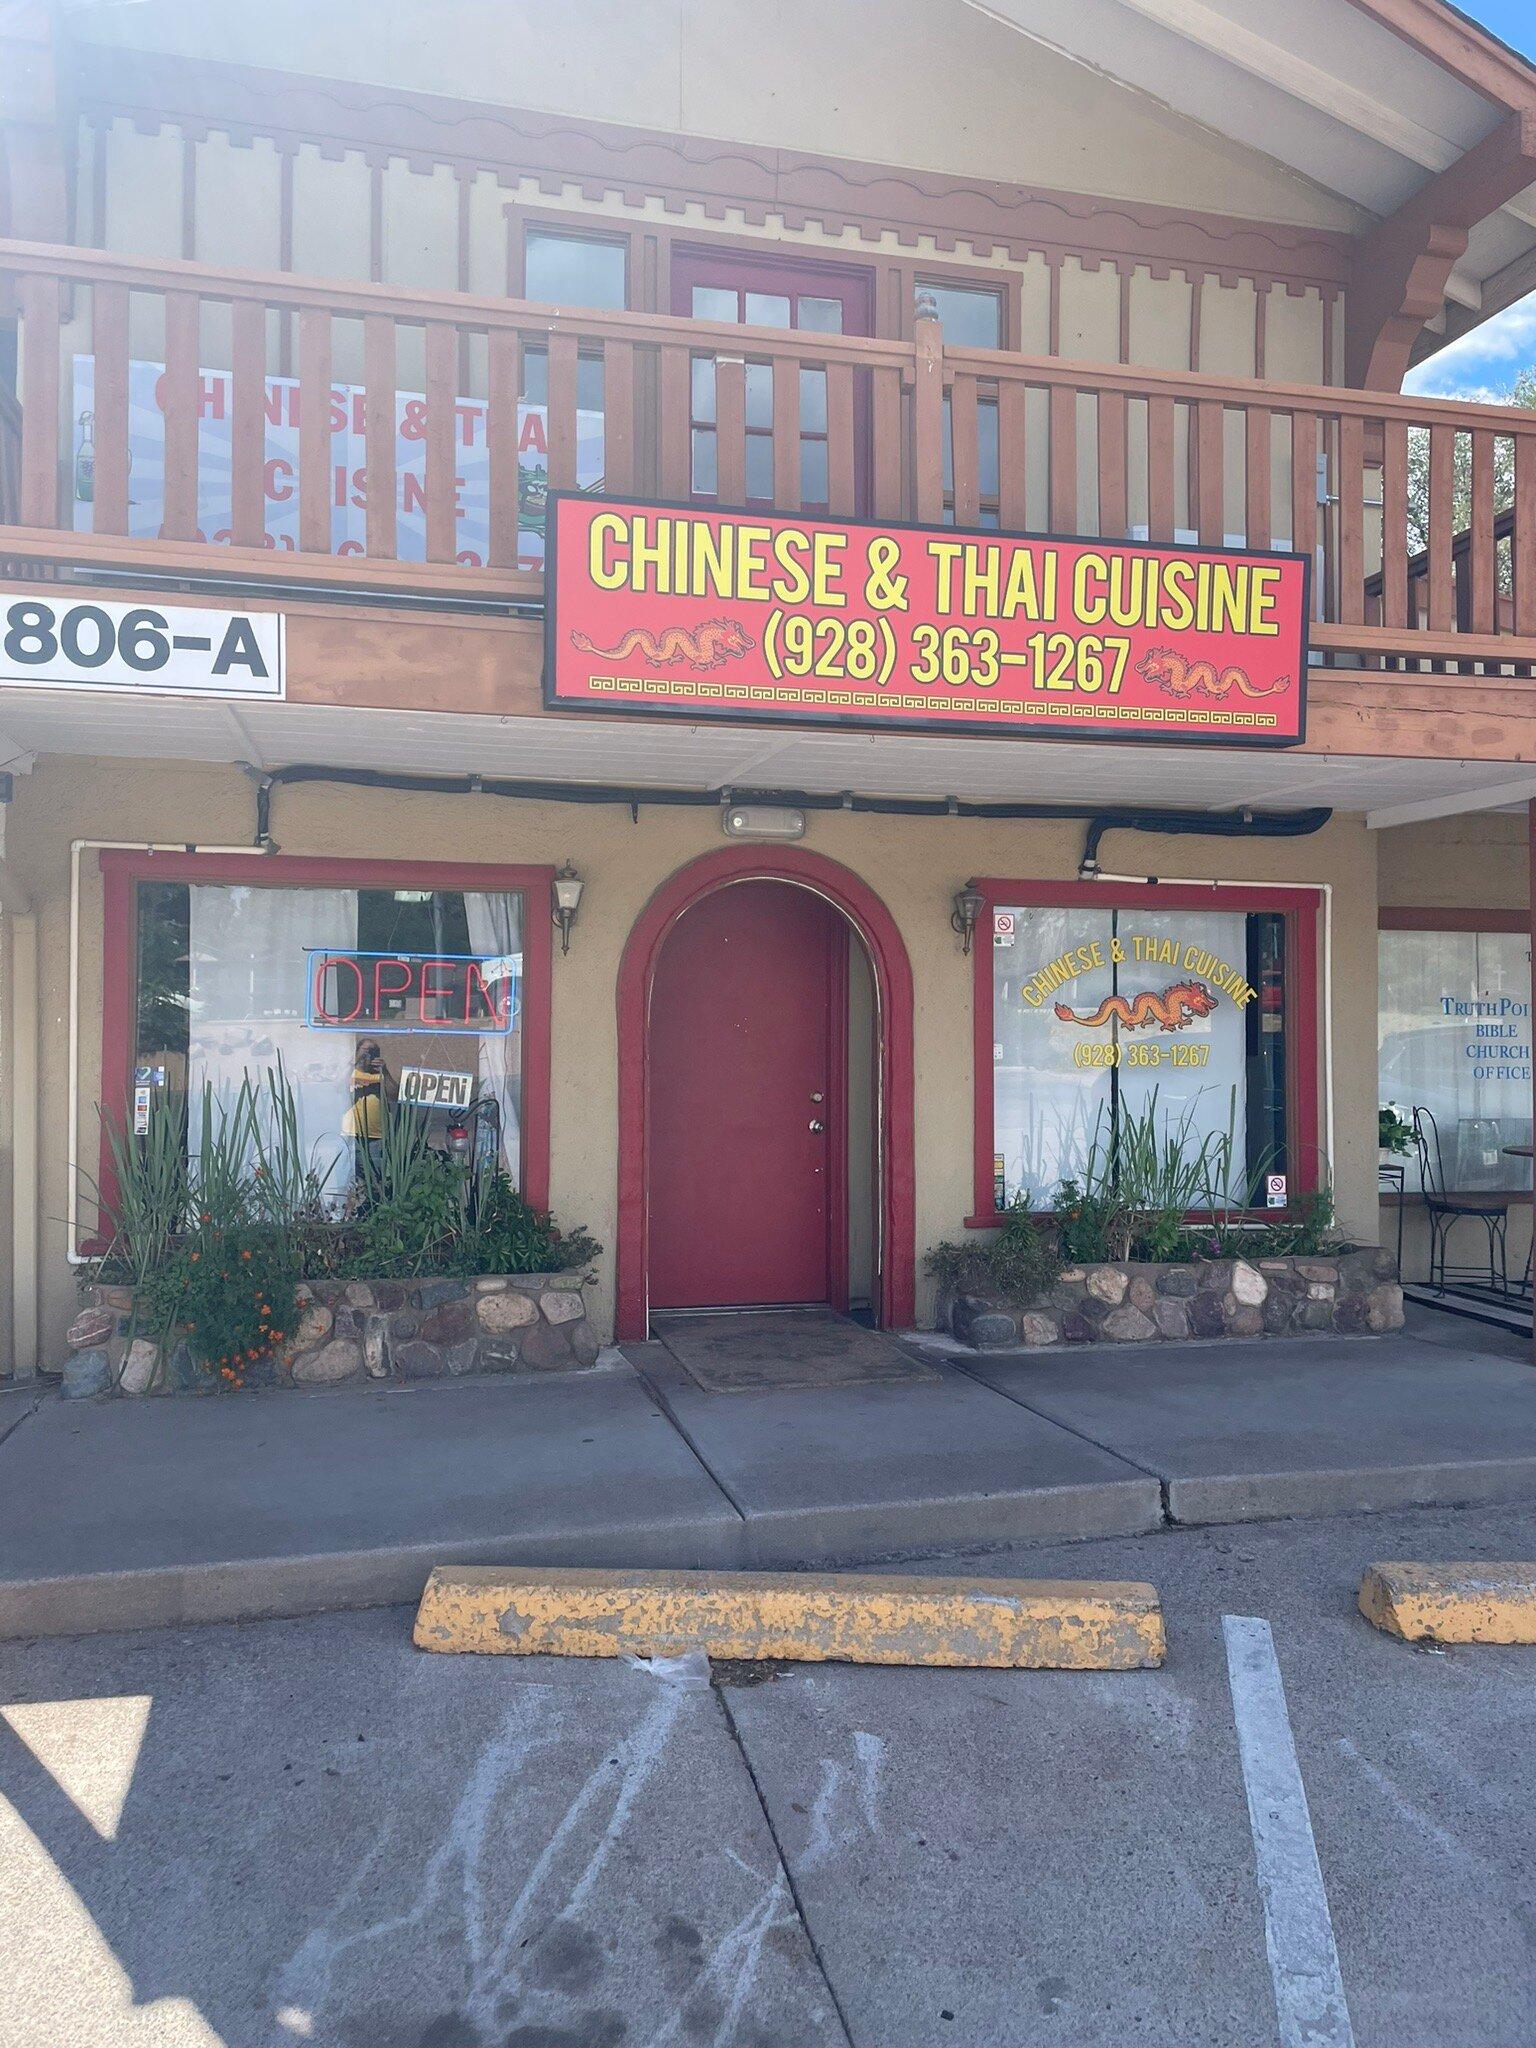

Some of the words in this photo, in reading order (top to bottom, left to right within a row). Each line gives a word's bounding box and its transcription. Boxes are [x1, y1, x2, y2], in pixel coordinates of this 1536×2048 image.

[589, 512, 847, 607] CHINESE
[865, 536, 910, 612] &
[927, 541, 1058, 622] THAI
[1073, 553, 1281, 636] CUISINE
[4, 601, 269, 678] 806-A
[763, 609, 897, 686] (928)
[910, 625, 1131, 694] 363-1267
[315, 957, 509, 1027] OPEN
[1021, 941, 1106, 1007] CHINESE
[1110, 936, 1127, 963] &
[1132, 935, 1181, 966] THAI
[1182, 945, 1258, 1010] CUISINE
[1073, 1042, 1122, 1068] (928)
[1127, 1044, 1210, 1068] 363-1267
[1466, 1044, 1530, 1059] CHURCH
[1476, 1024, 1518, 1038] BIBLE
[404, 1071, 467, 1106] OPEN
[1473, 1066, 1531, 1080] OFFICE
